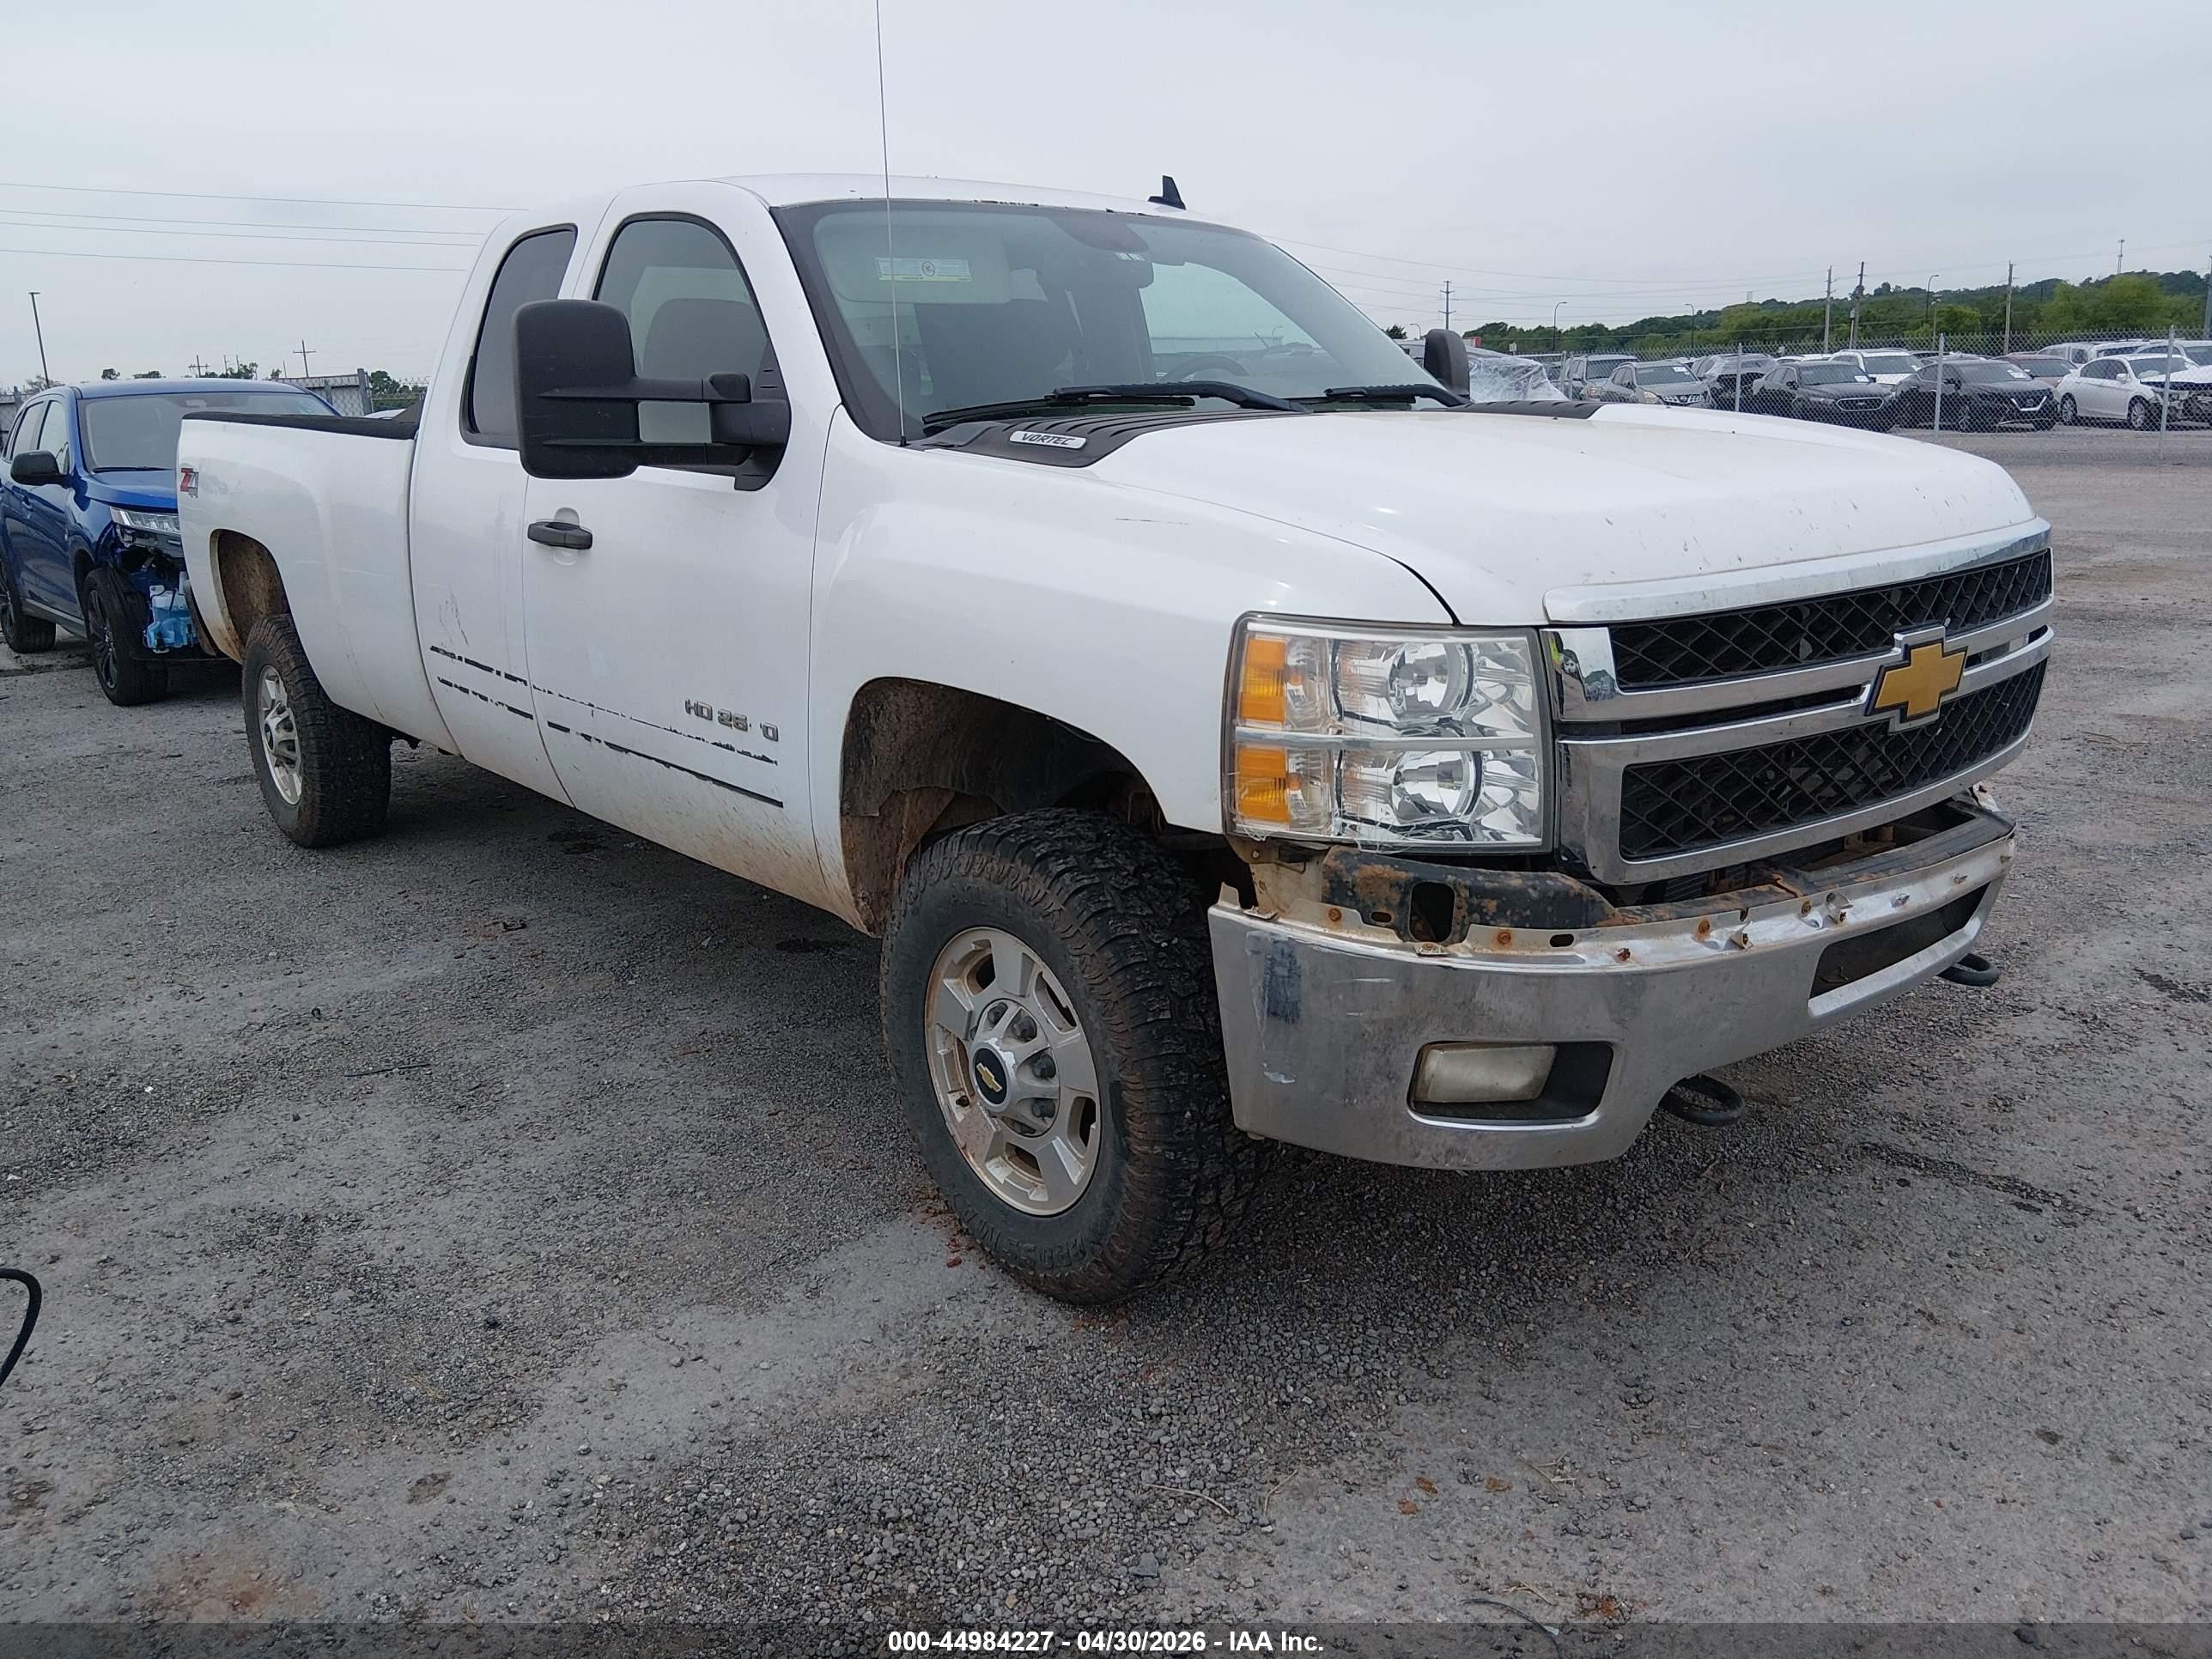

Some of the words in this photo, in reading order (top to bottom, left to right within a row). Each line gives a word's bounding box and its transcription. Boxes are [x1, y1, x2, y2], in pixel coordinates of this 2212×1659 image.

[1022, 433, 1074, 446] VORTEC
[684, 698, 714, 721] HD
[717, 708, 779, 743] 250
